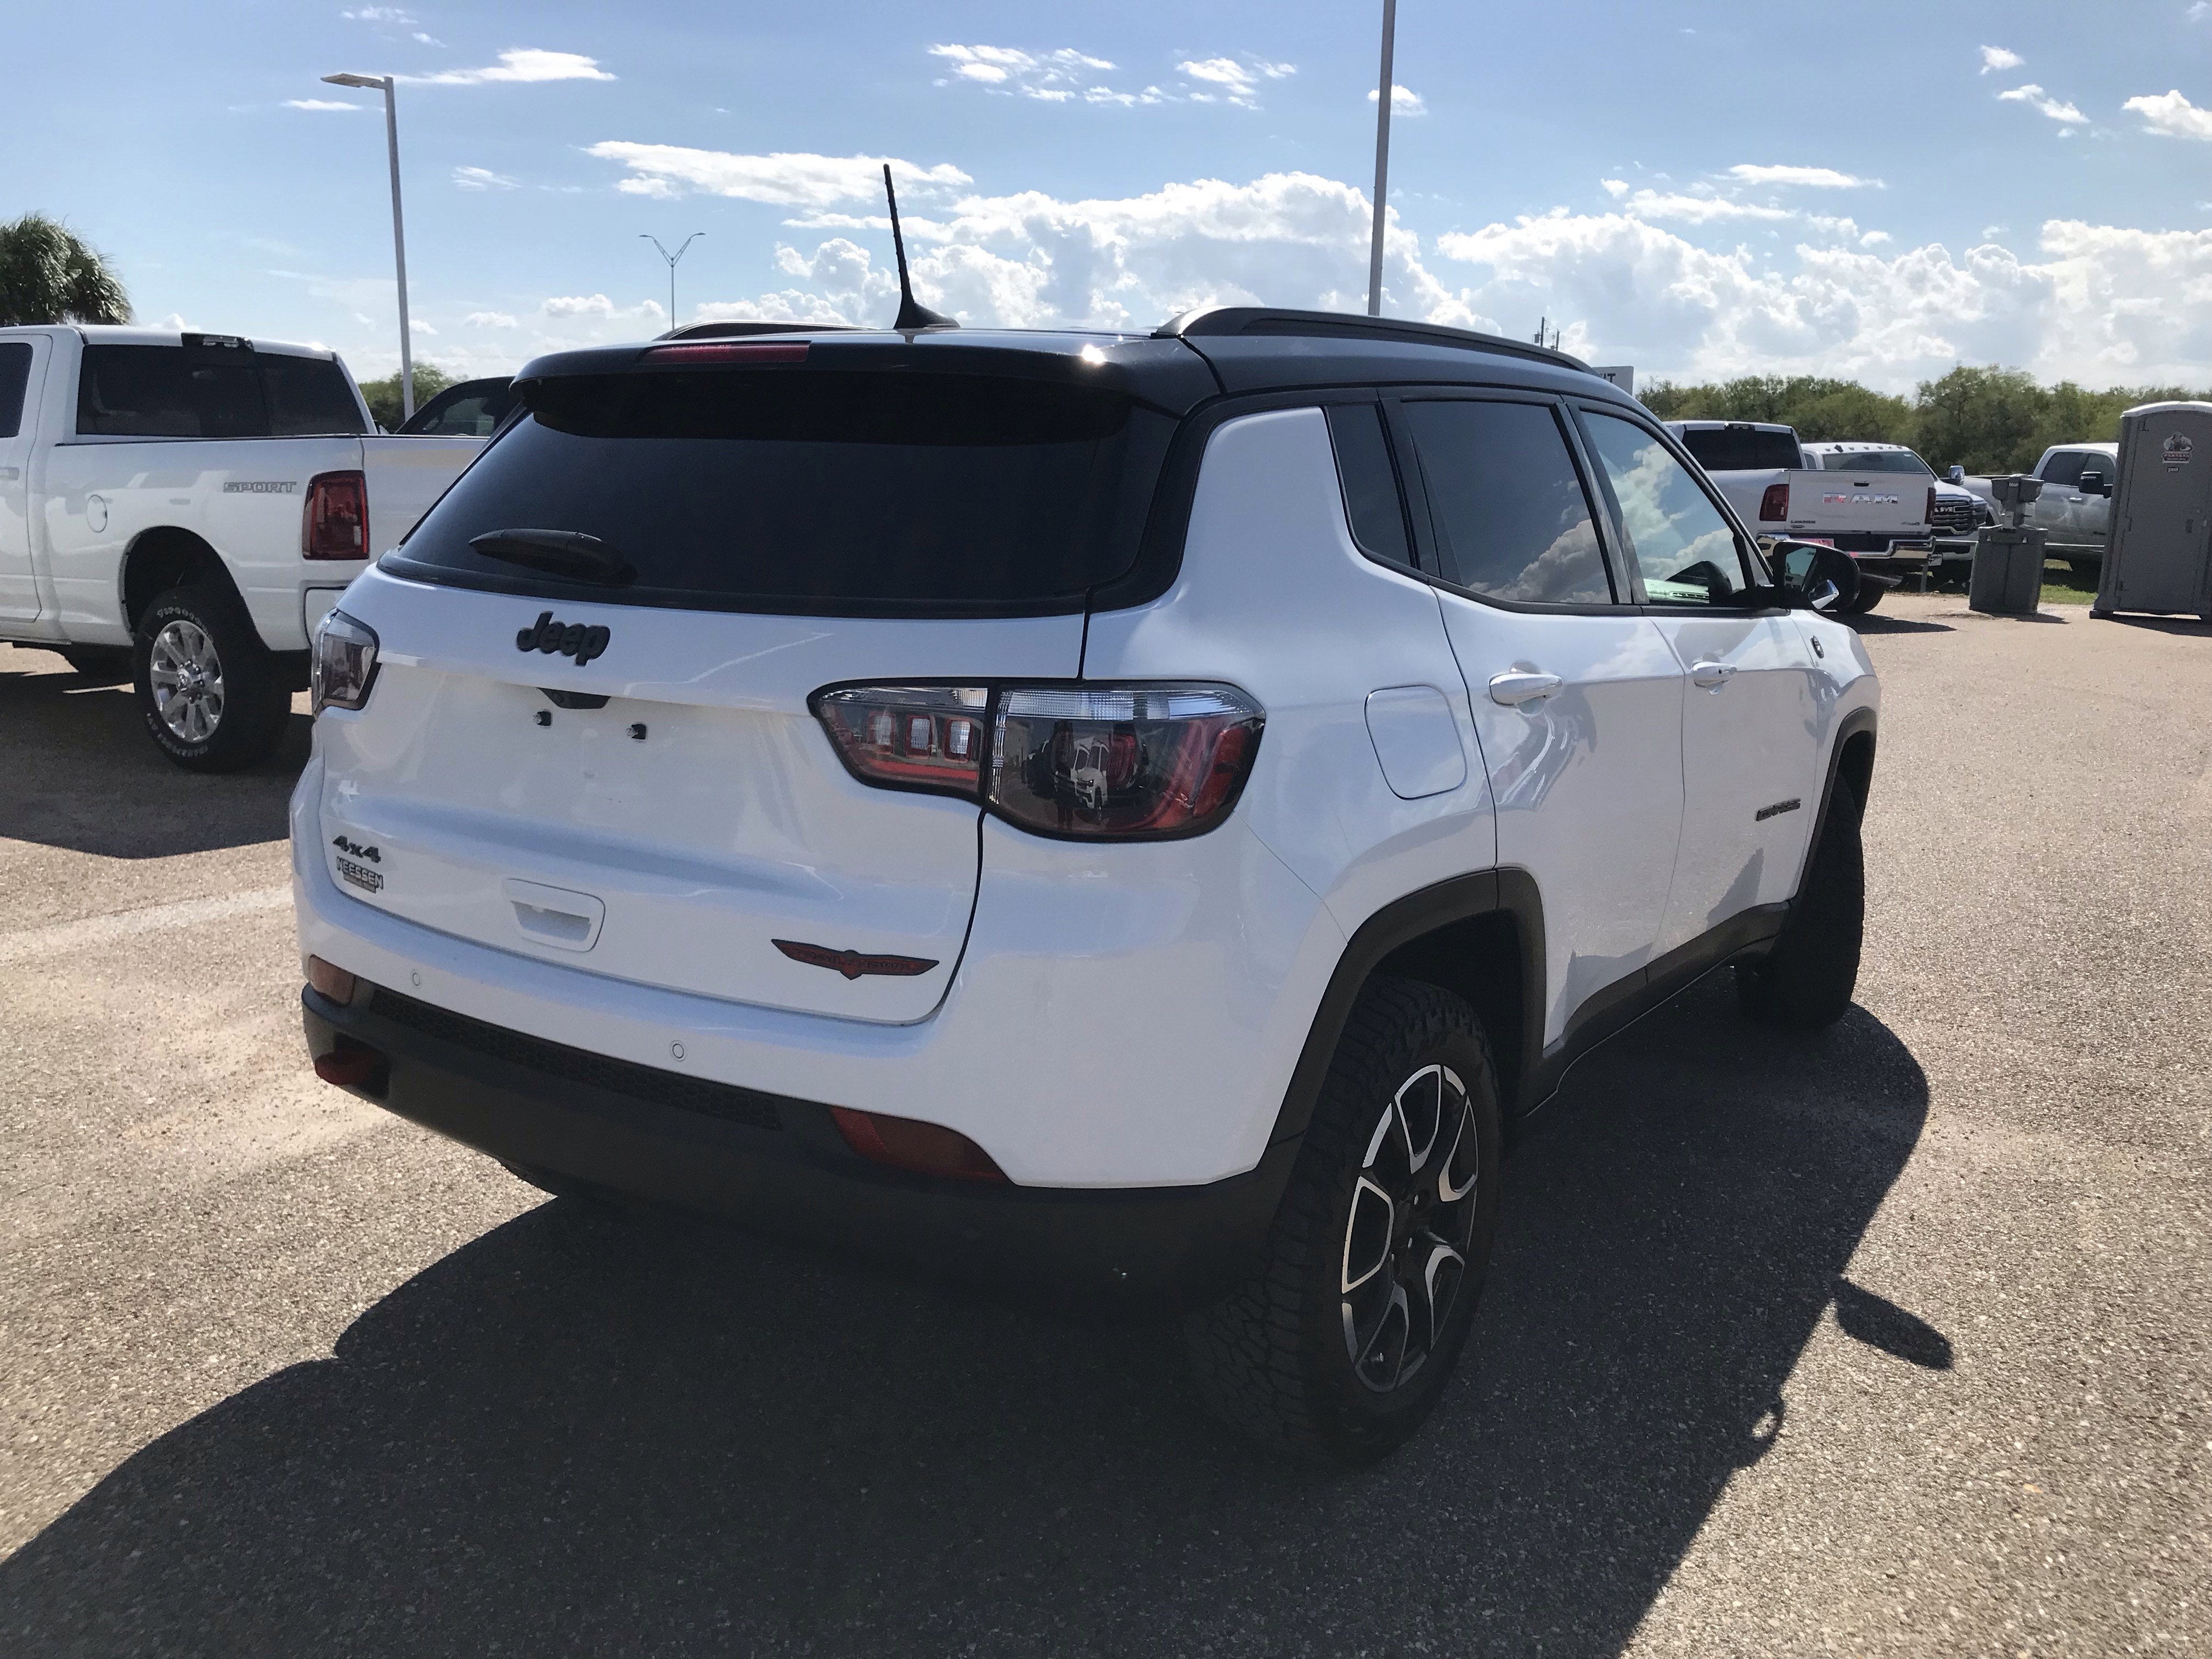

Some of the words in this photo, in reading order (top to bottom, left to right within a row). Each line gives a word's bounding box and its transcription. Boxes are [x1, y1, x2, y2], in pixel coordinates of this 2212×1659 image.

[223, 481, 297, 493] SPORT
[1822, 493, 1899, 504] RAM
[516, 611, 611, 667] Jeep
[336, 856, 383, 890] NEESSEN
